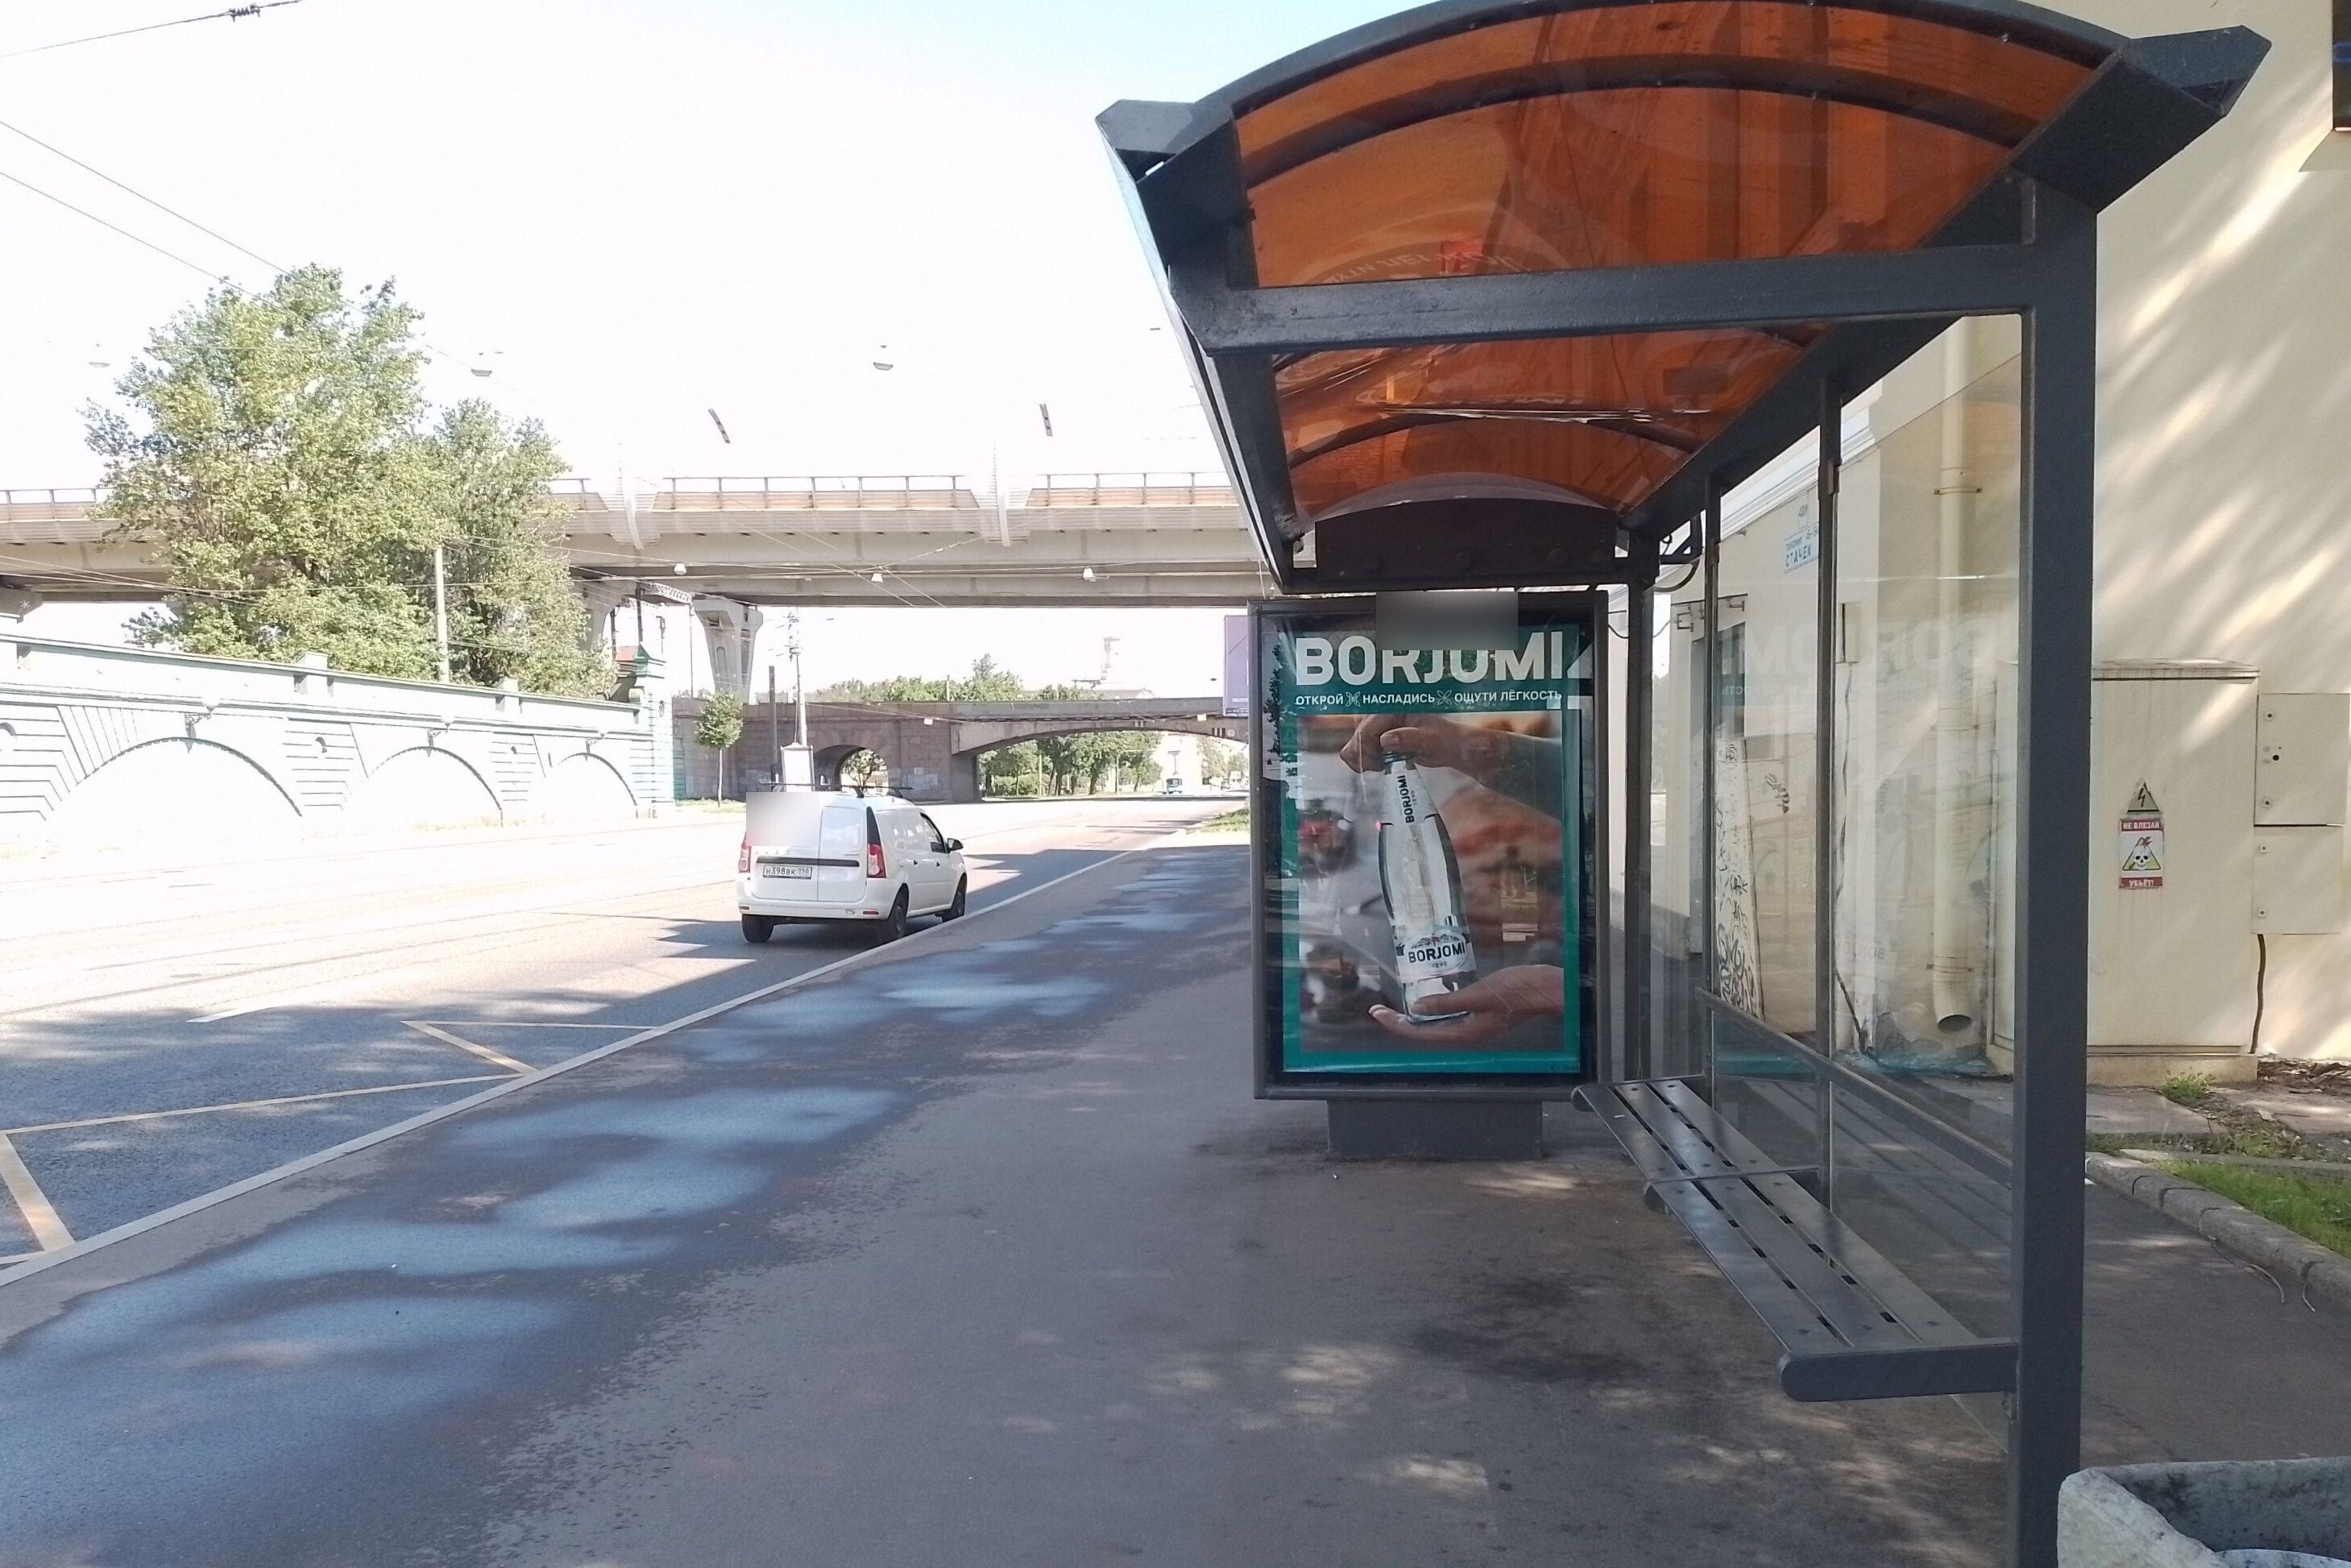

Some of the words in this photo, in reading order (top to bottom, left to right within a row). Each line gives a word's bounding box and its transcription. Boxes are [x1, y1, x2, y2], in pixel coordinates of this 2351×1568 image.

[1295, 692, 1344, 705] ОТКРОЙ
[1362, 693, 1436, 705] НАСЛАДИСЬ
[1453, 692, 1497, 703] ОЩУТИ
[1500, 690, 1562, 701] ЛЁГКОСТЬ
[1396, 775, 1415, 823] BORJOMI
[2123, 822, 2133, 830] НЕ
[2133, 820, 2160, 829] ВЛЕЗАЙ
[1408, 942, 1466, 963] BORJOMI
